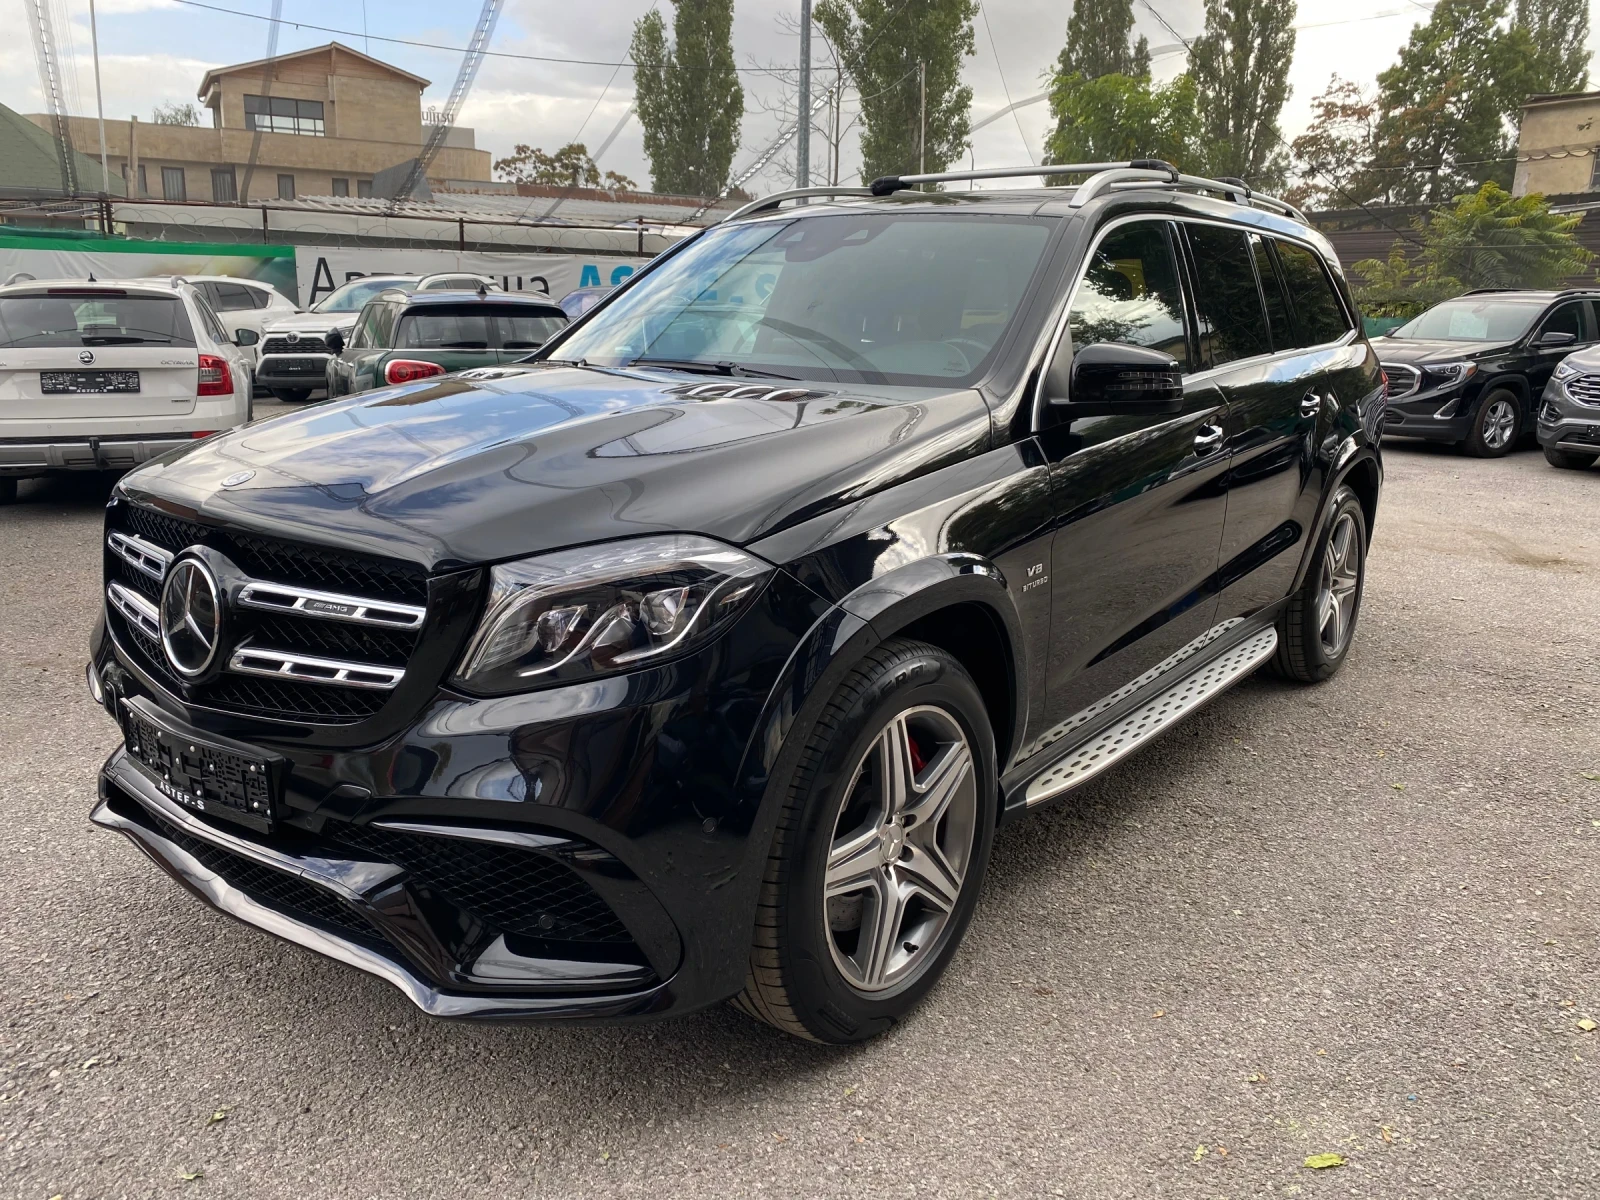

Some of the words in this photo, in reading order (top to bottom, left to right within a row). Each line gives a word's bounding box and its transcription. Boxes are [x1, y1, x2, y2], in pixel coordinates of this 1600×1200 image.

[421, 105, 454, 124] UJITSU
[1026, 563, 1043, 577] V8
[1022, 575, 1048, 592] BITURBO
[160, 781, 205, 810] ASTEF-S
